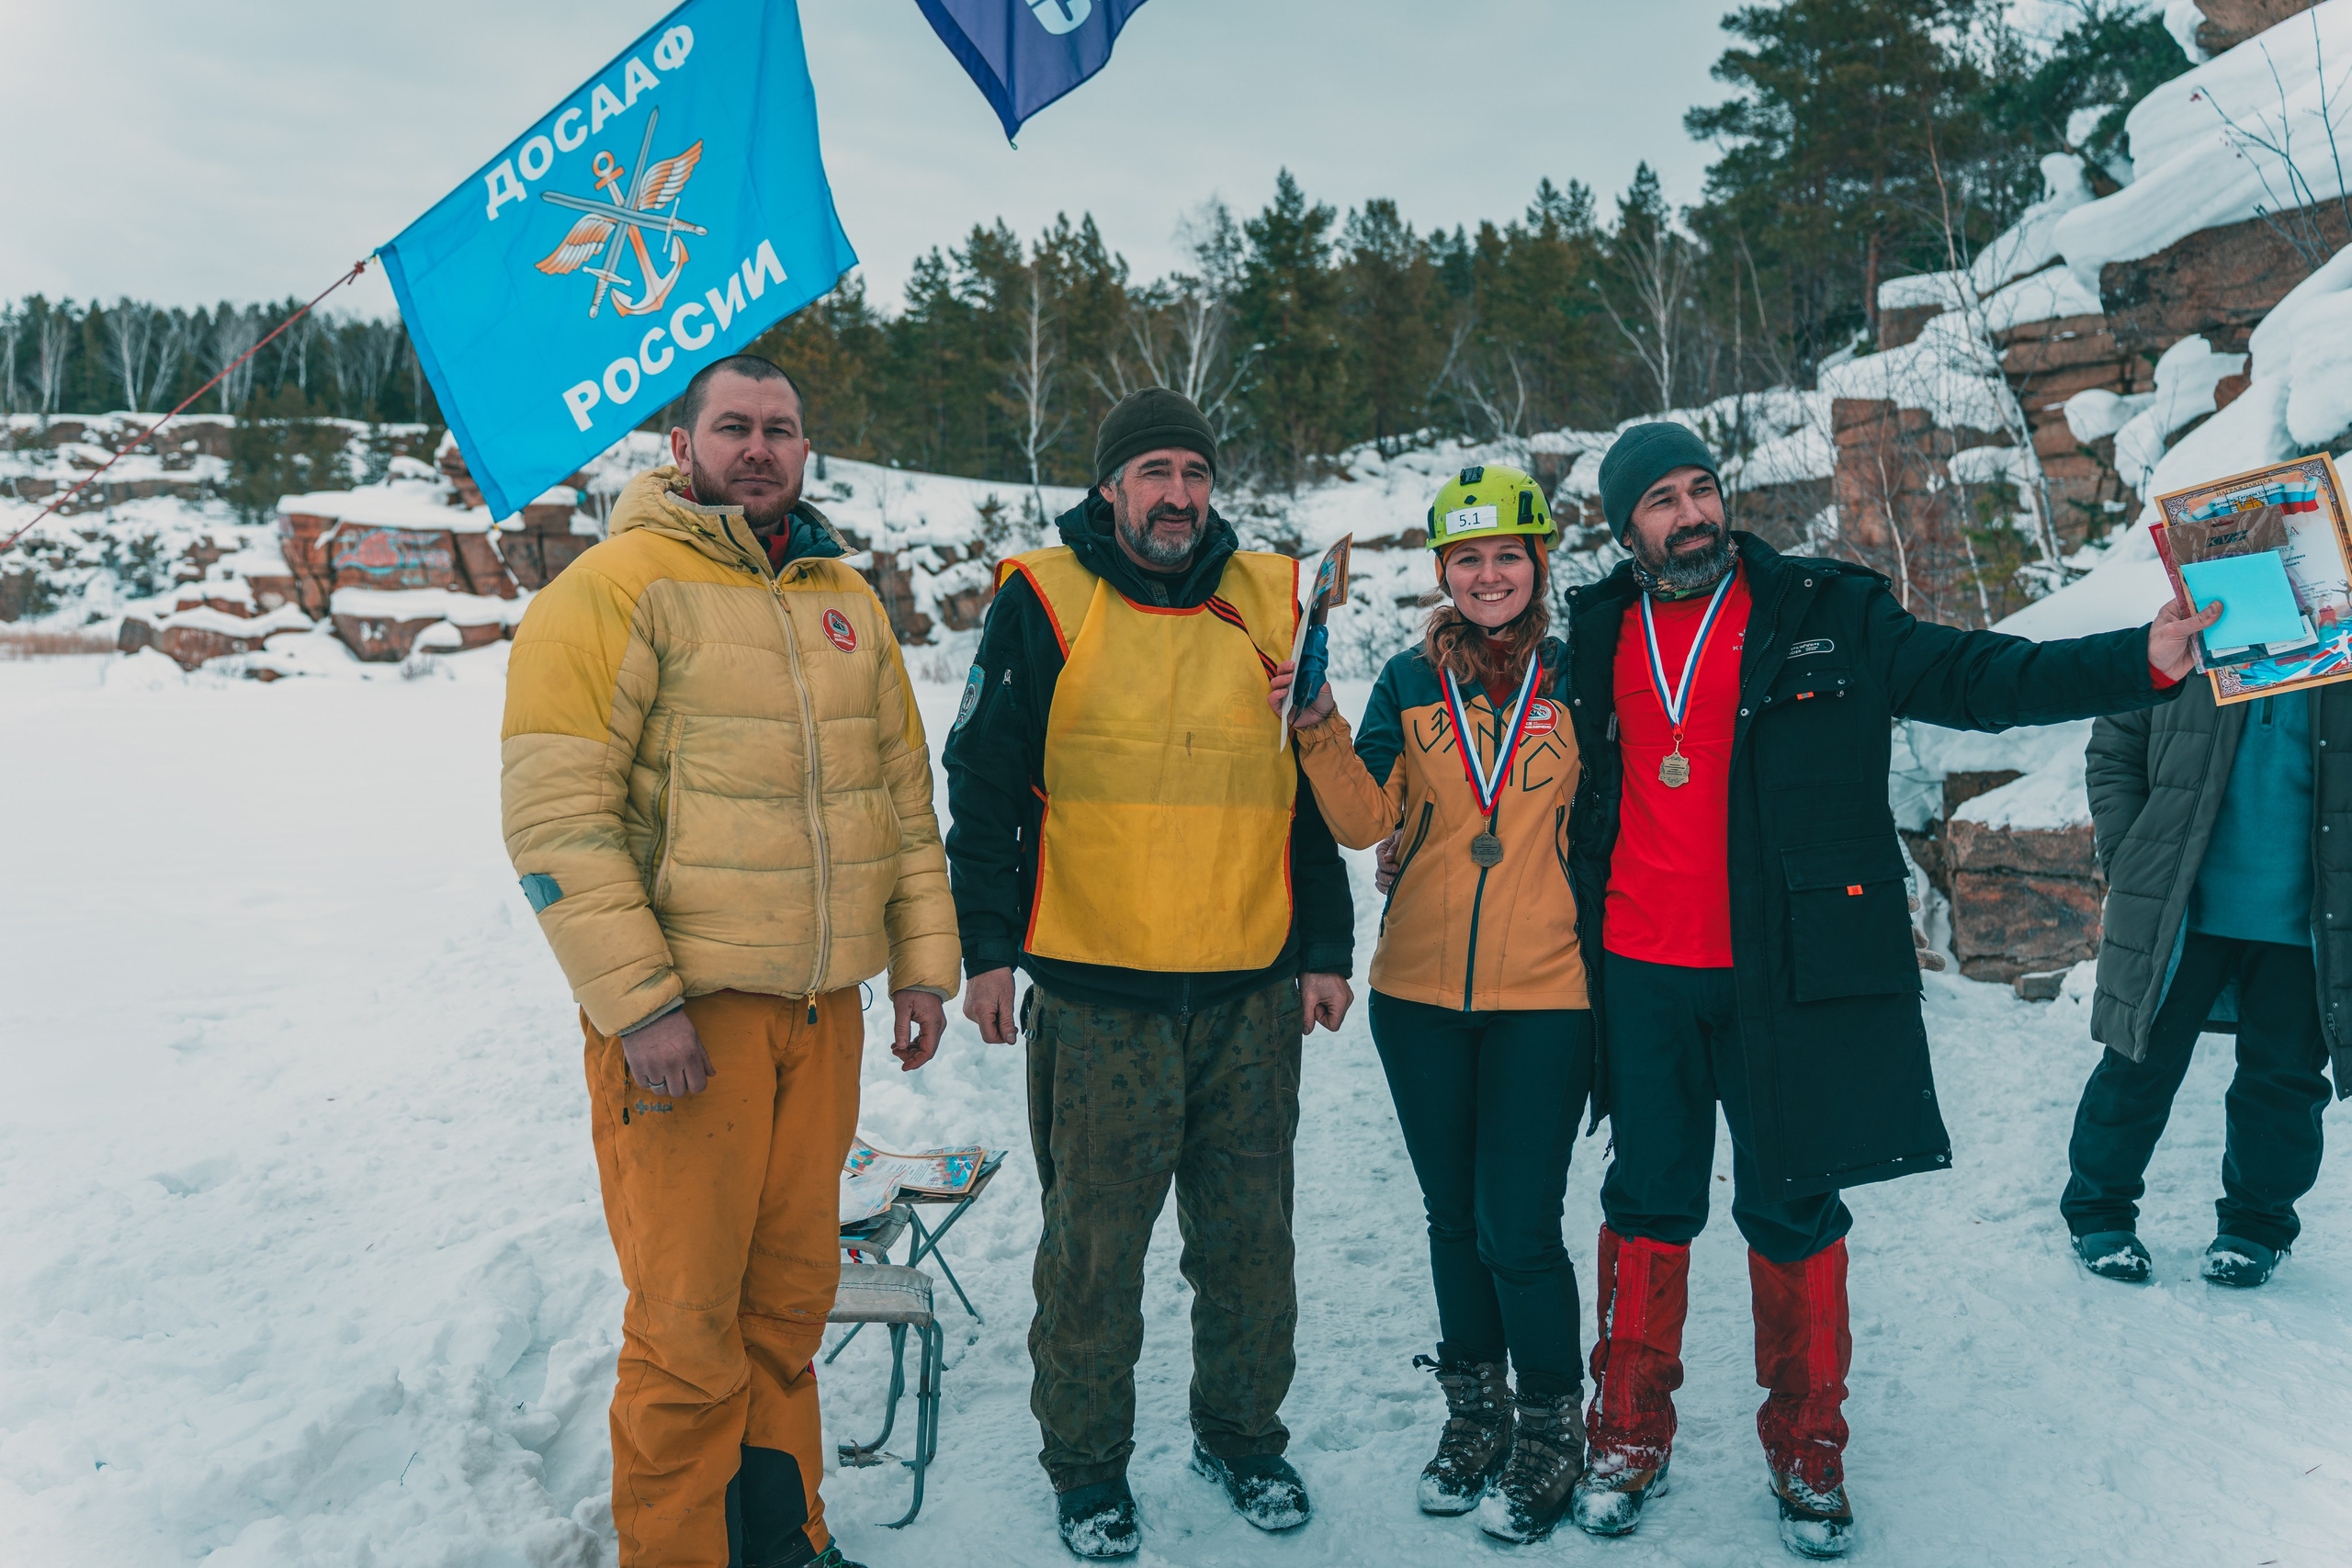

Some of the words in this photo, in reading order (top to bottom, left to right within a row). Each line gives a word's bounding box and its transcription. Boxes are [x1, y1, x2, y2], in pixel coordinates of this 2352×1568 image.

[484, 24, 695, 220] ДОСААФ
[562, 238, 787, 432] РОССИИ
[1459, 512, 1481, 527] 5.1
[650, 1101, 673, 1113] kilpi
